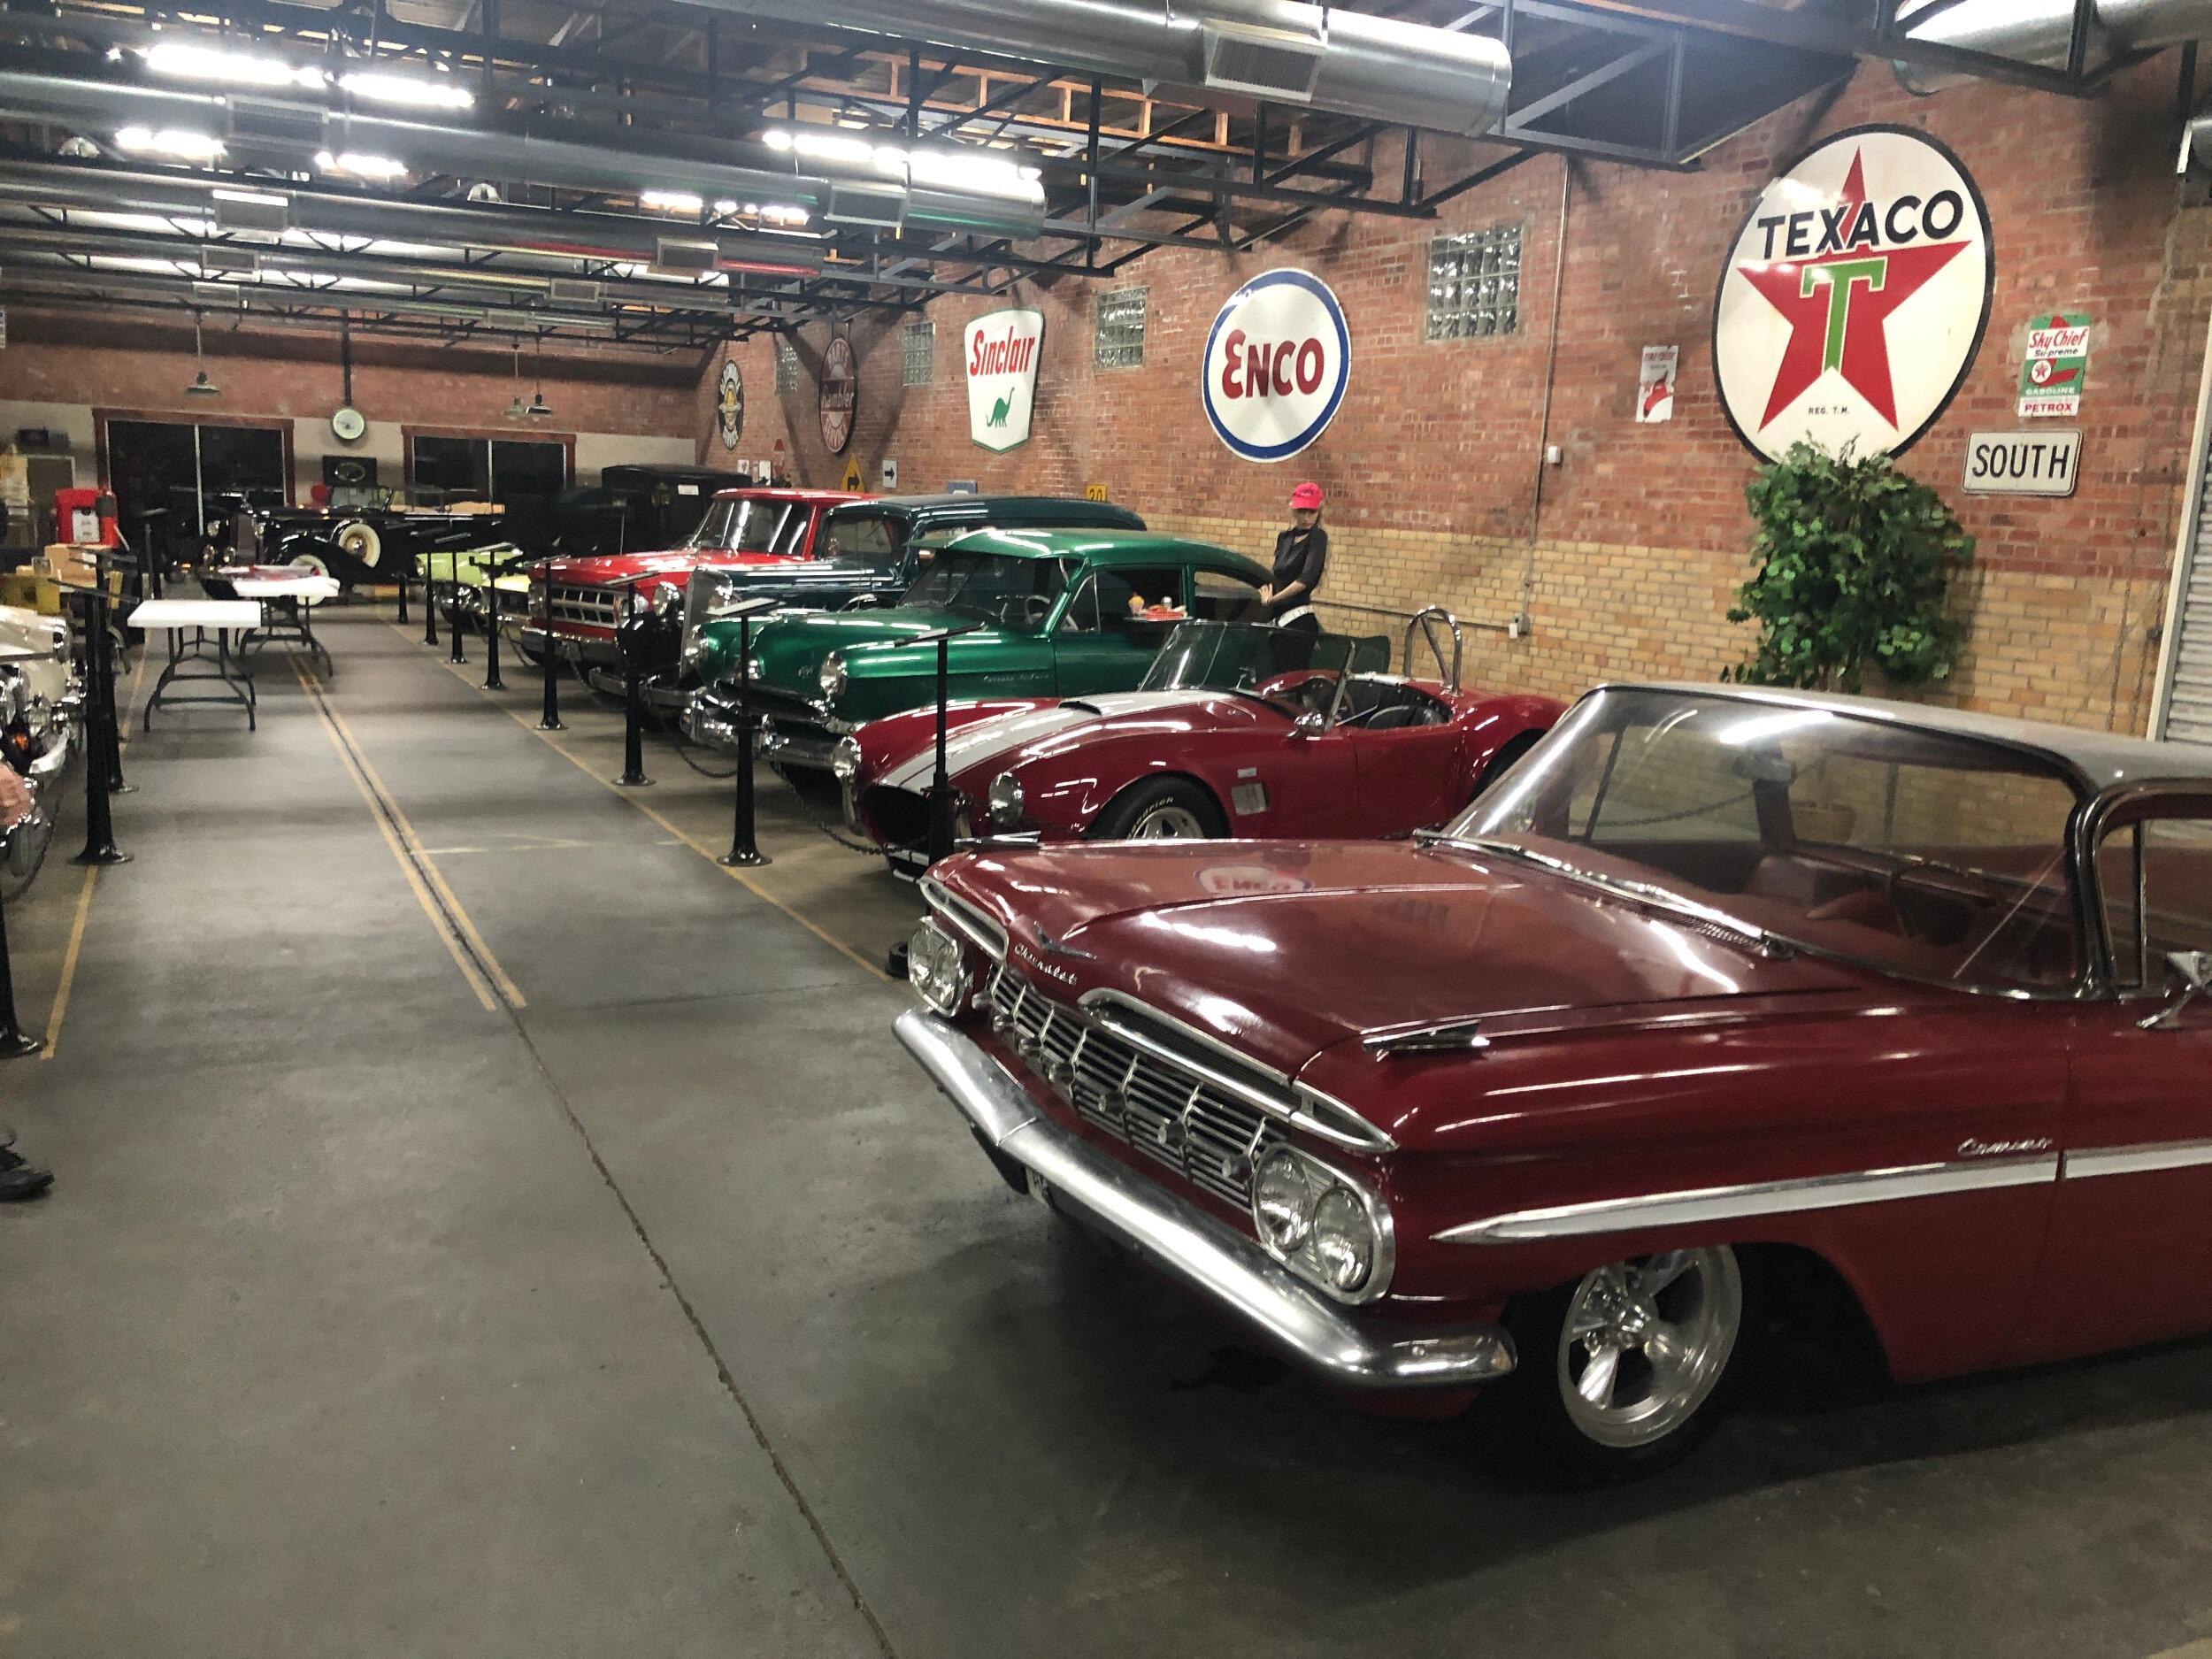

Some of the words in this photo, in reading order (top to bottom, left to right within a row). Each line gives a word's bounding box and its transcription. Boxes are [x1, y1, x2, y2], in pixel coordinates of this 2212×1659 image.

[1757, 189, 1964, 260] TEXACO
[1800, 257, 1888, 374] T
[970, 326, 1035, 376] Sinclair
[2030, 333, 2053, 349] Sky
[2053, 329, 2088, 346] Chief
[1222, 328, 1325, 400] ENCO
[820, 382, 855, 408] Rambler
[1809, 406, 1828, 416] REG.
[2024, 403, 2072, 412] PETROX
[1972, 444, 2070, 479] SOUTH
